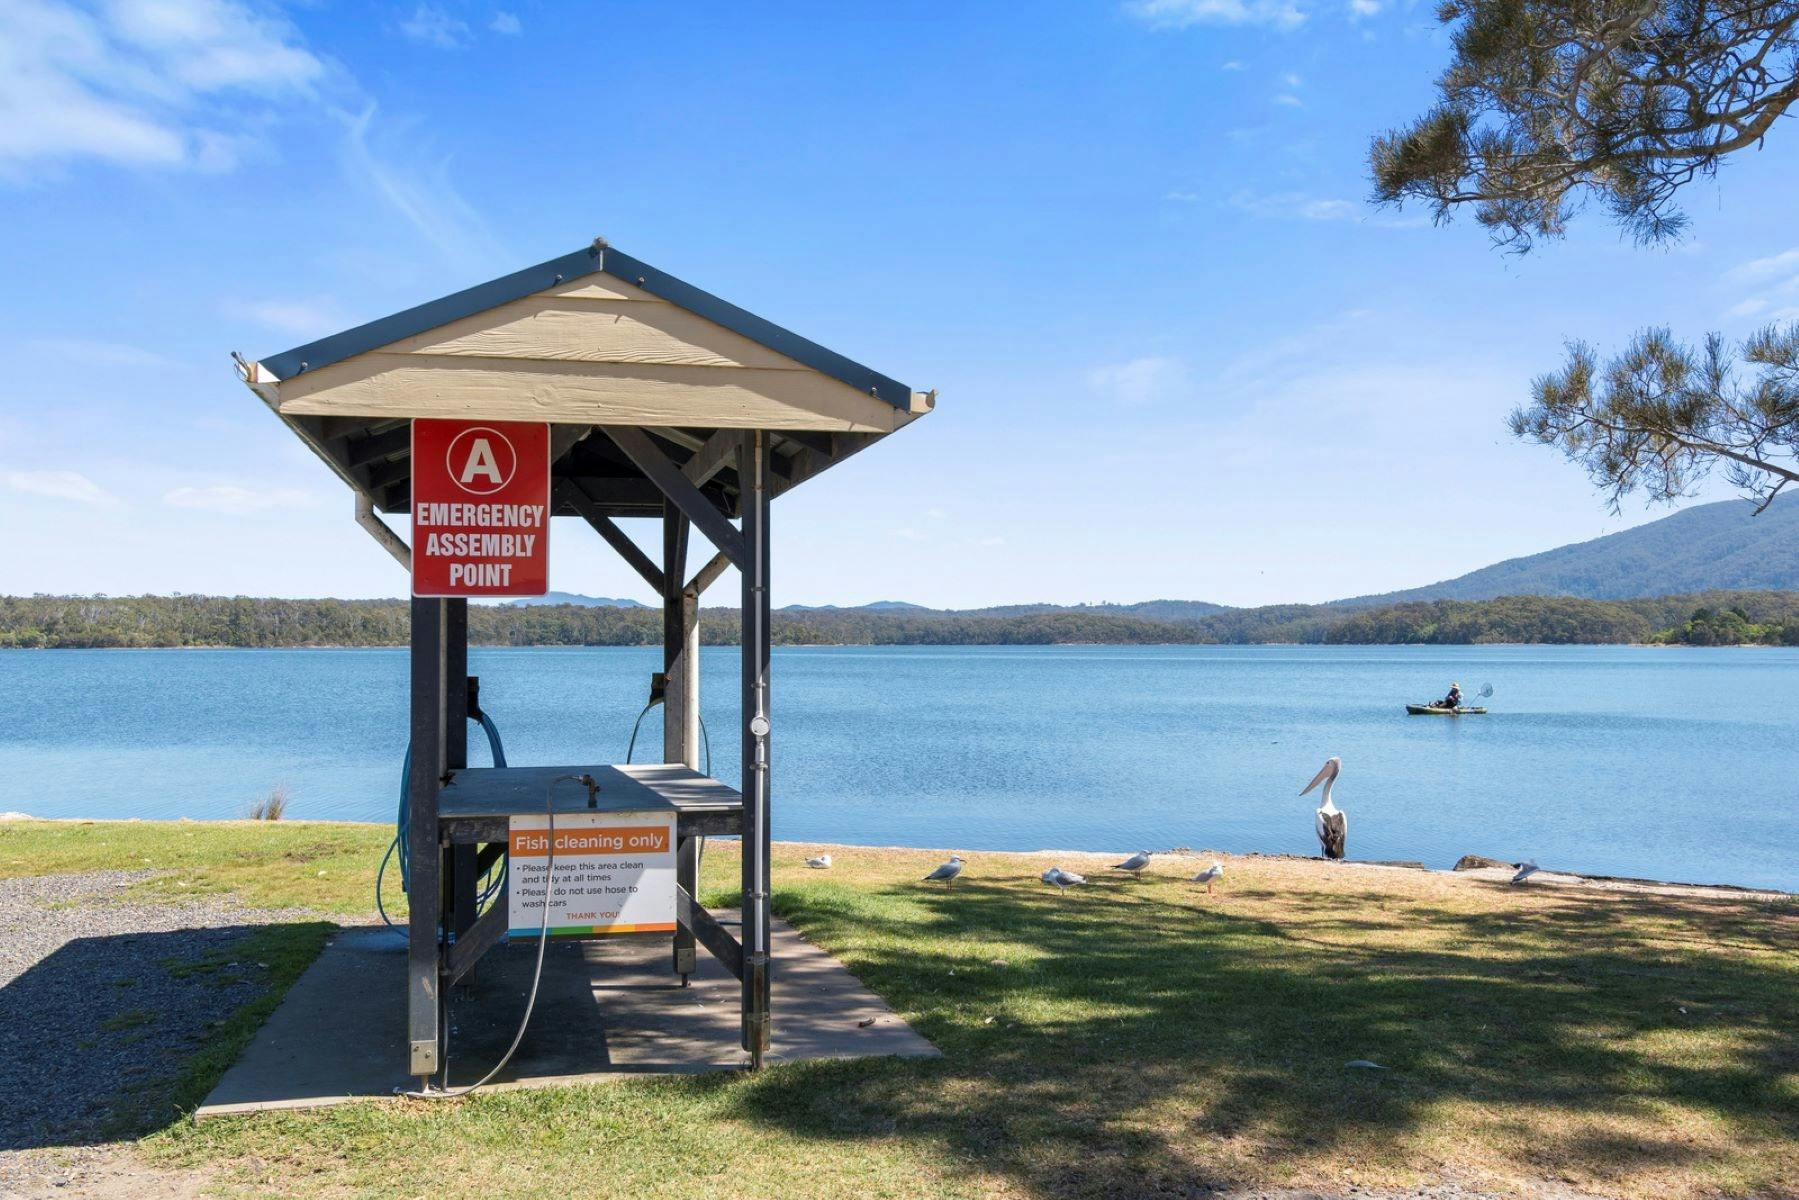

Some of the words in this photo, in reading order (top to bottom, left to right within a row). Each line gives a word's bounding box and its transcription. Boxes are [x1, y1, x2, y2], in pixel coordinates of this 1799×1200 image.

[460, 438, 503, 484] A
[417, 502, 544, 528] EMERGENCY
[425, 533, 536, 557] ASSEMBLY
[450, 563, 512, 587] POINT
[516, 835, 549, 850] Fish
[554, 833, 624, 850] cleaning
[629, 832, 664, 849] only
[554, 863, 577, 872] keep
[579, 861, 596, 870] this
[597, 862, 618, 870] area
[619, 860, 644, 870] clean
[522, 875, 540, 884] and
[542, 874, 560, 885] tdy
[562, 874, 572, 883] at
[574, 873, 584, 882] all
[587, 873, 612, 882] times
[522, 888, 549, 897] Pleas
[553, 887, 567, 896] do
[569, 886, 584, 895] not
[587, 886, 602, 895] use
[605, 885, 627, 894] hose
[628, 885, 638, 894] to
[522, 899, 546, 908] wash
[566, 912, 596, 920] THANK
